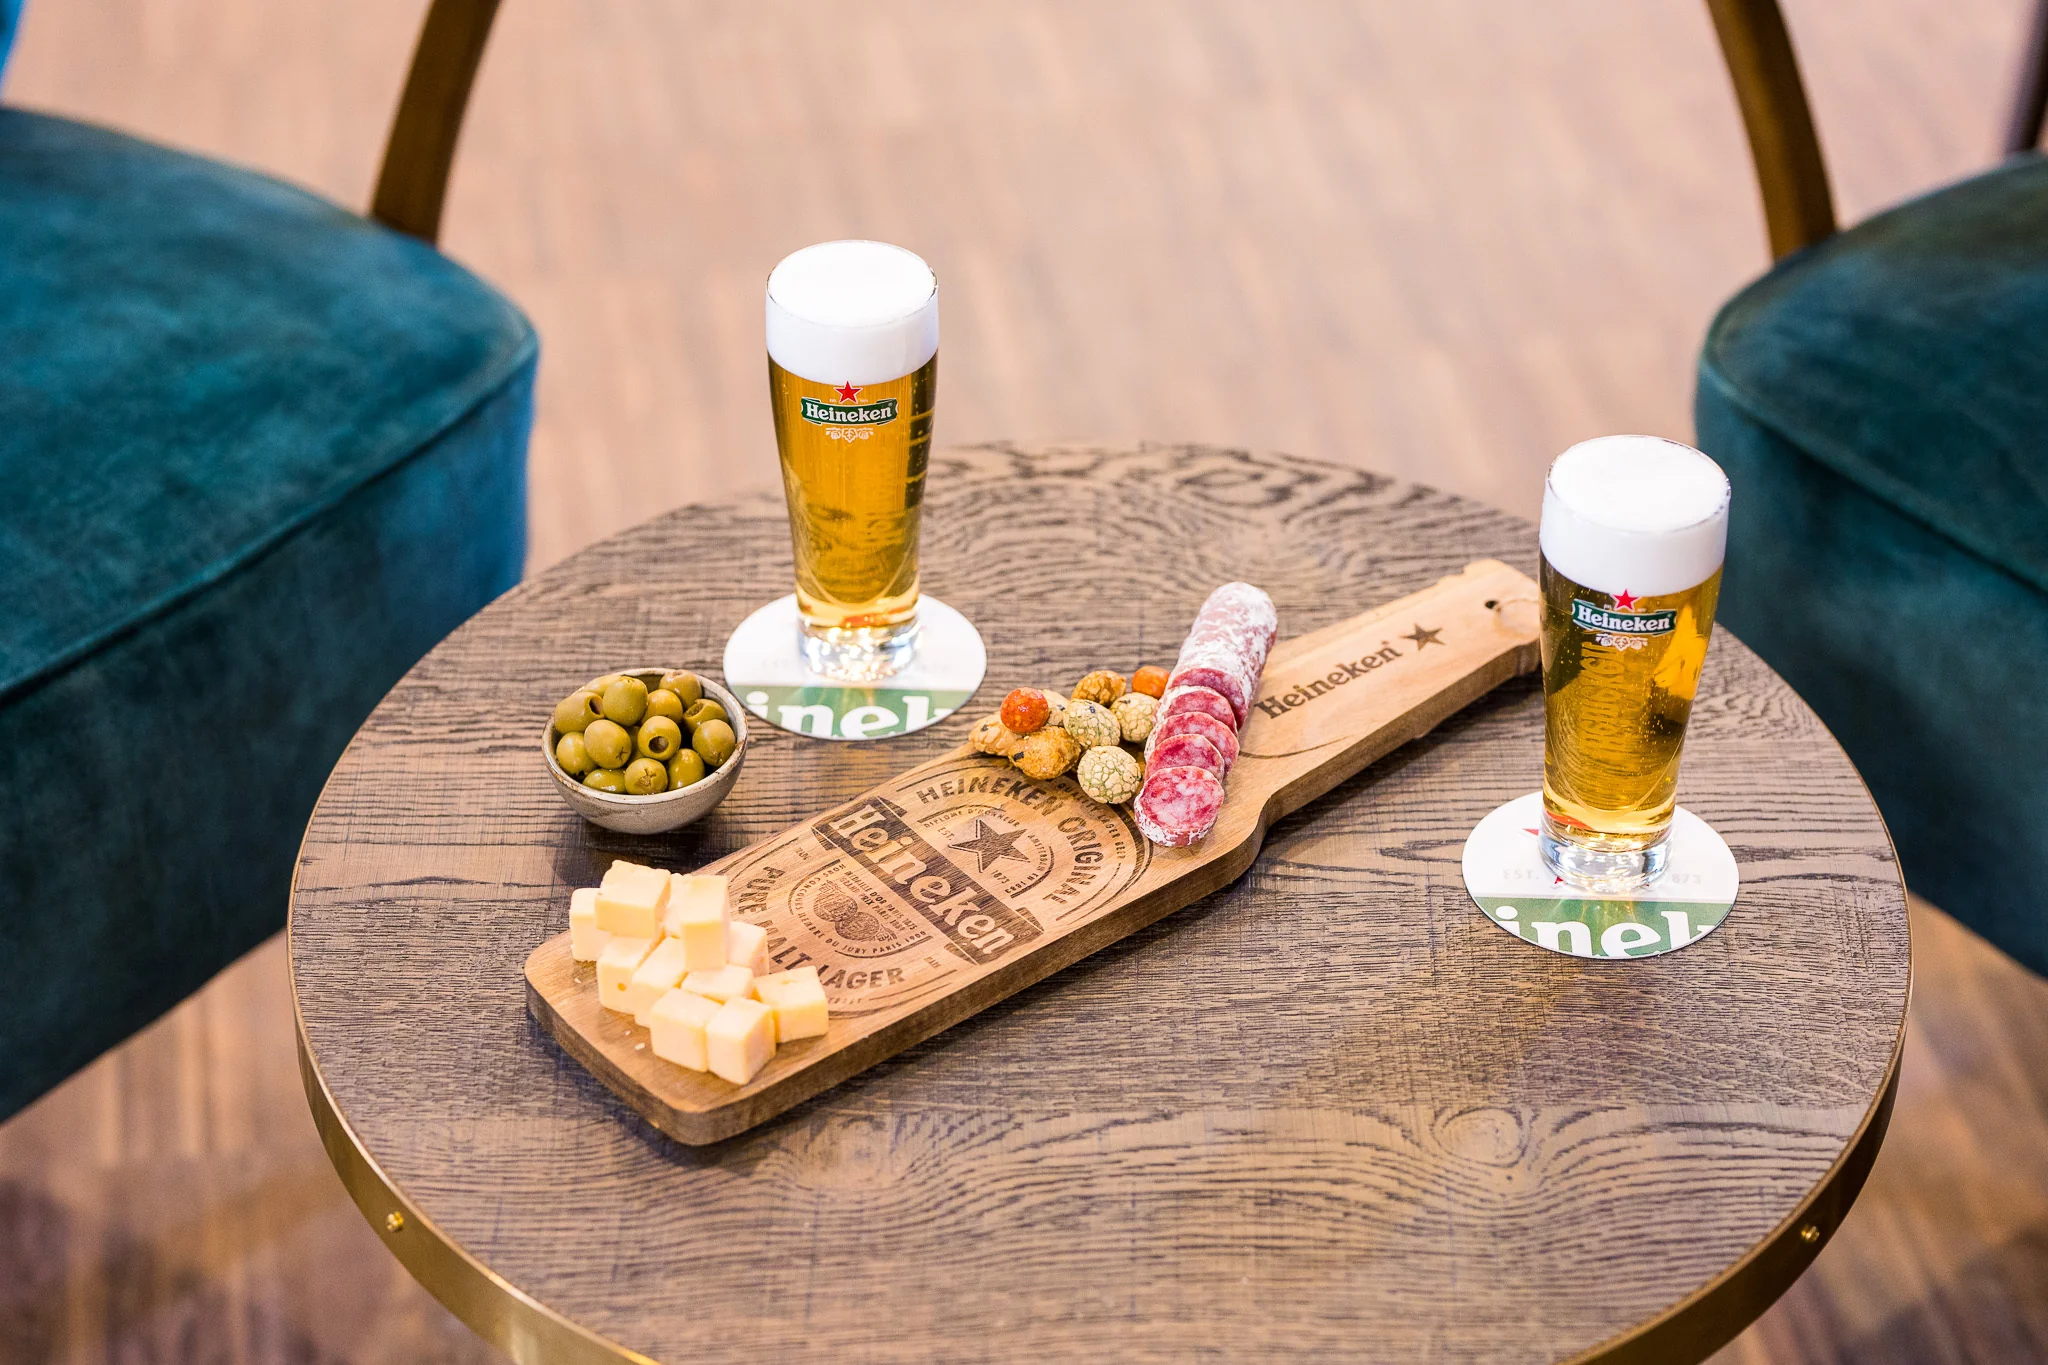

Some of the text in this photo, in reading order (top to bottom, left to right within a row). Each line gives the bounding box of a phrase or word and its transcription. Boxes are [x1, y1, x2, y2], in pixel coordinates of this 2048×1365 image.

[806, 402, 892, 422] Heineken
[1577, 604, 1671, 631] Heineken
[1254, 643, 1403, 719] Heineken
[916, 776, 1104, 904] HEINEKEN ORIGINAL
[828, 804, 1015, 954] Heineken
[1671, 873, 1701, 884] 873
